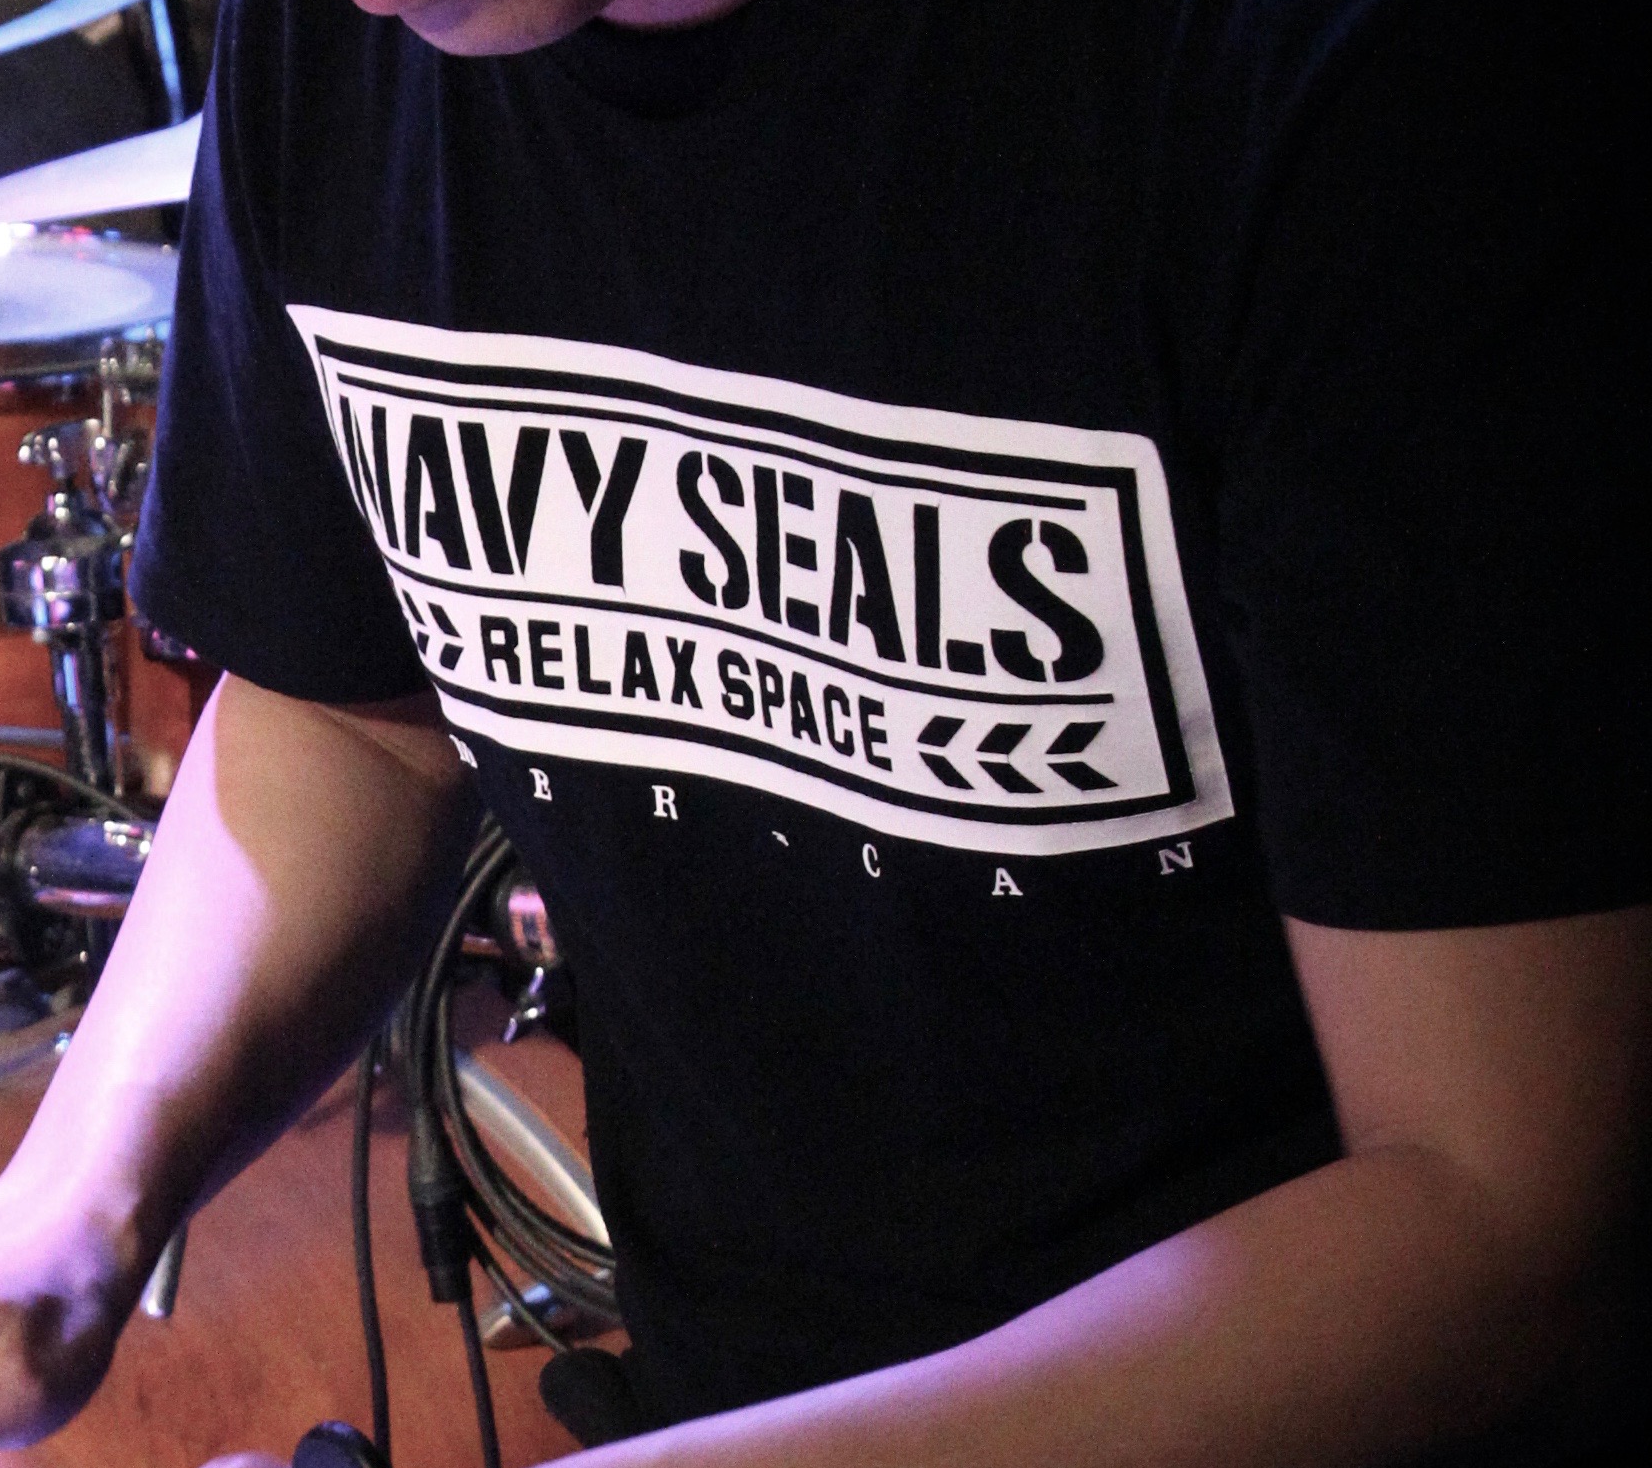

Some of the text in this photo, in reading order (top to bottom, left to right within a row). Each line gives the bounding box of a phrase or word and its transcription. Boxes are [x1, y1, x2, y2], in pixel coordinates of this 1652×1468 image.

[340, 395, 1104, 684] NAVY SEALS
[479, 614, 894, 772] RELAX SPACE
